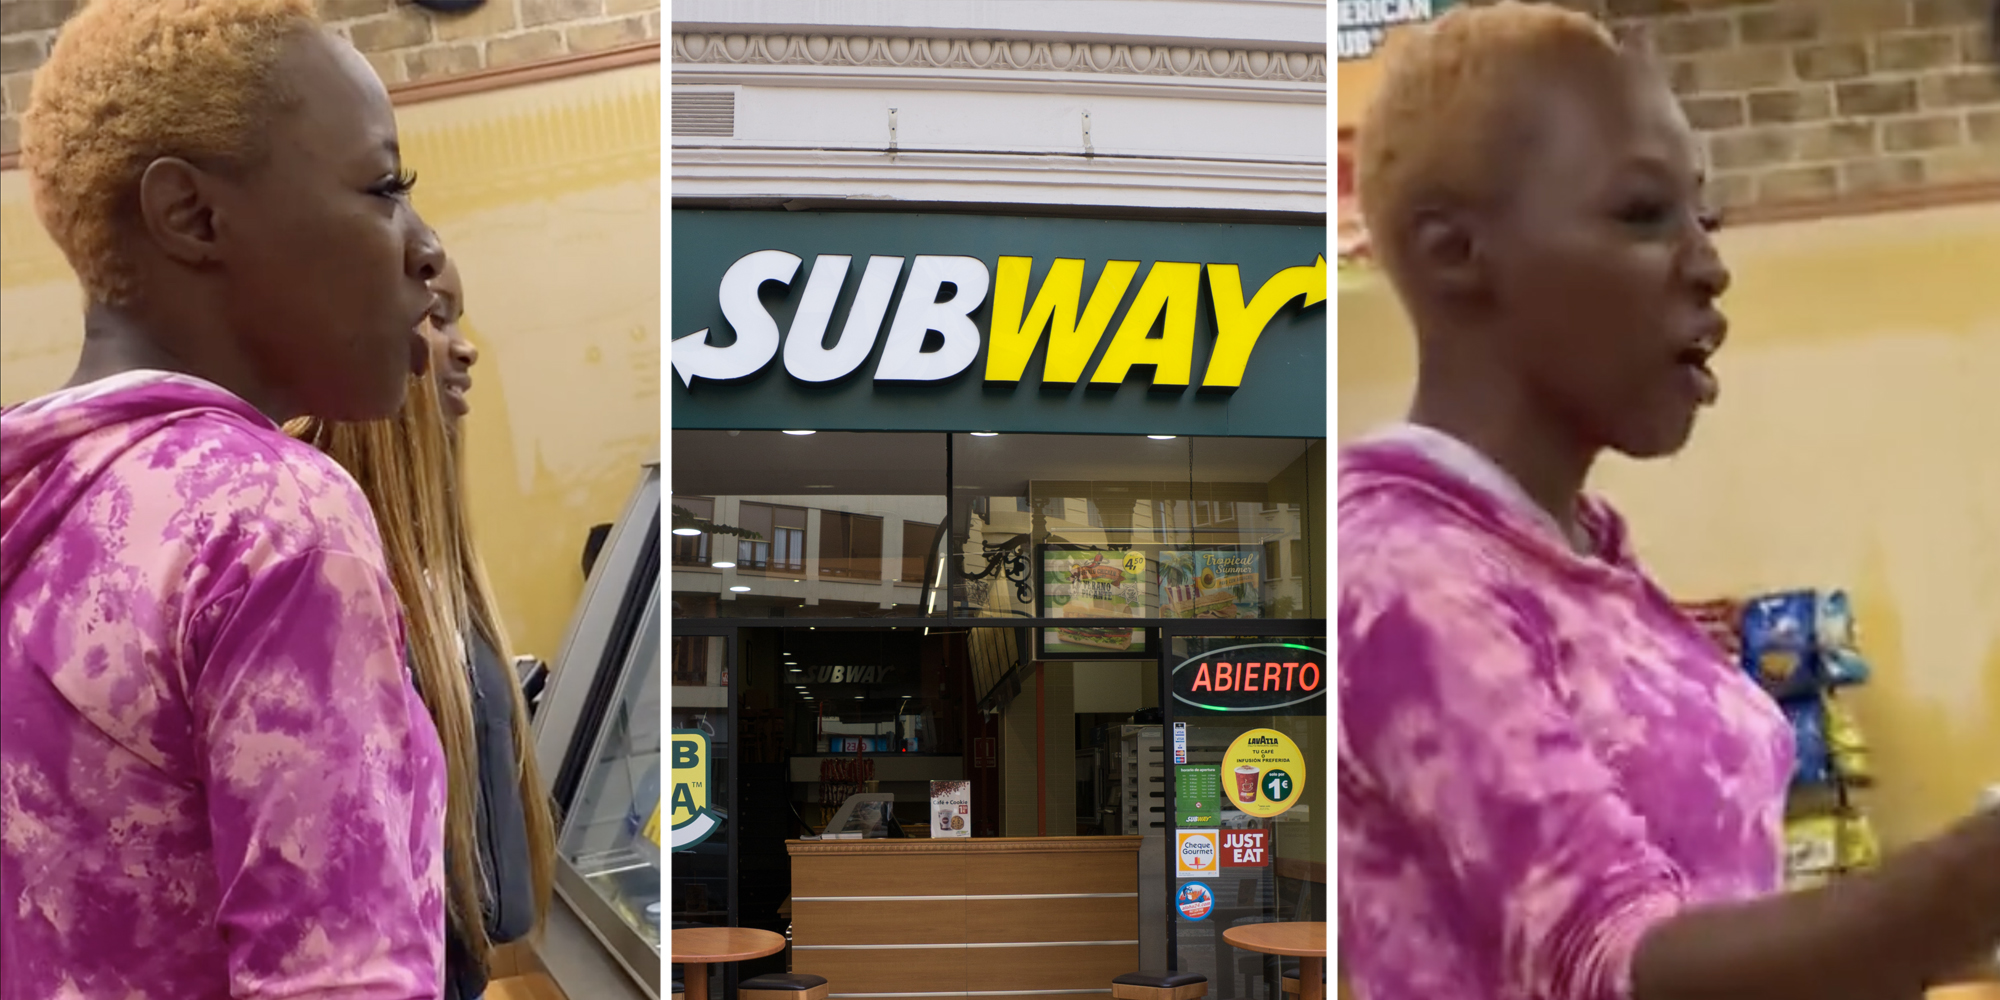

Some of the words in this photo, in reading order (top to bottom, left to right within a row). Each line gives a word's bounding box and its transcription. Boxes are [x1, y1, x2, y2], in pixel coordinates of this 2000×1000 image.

[672, 248, 1326, 394] SUBWAY
[1203, 553, 1254, 566] Tropical
[1215, 565, 1252, 574] Summer
[1083, 580, 1112, 592] VERANO
[1081, 588, 1113, 601] PICANTE
[801, 664, 896, 684] SUBWAY
[1191, 661, 1321, 693] ABIERTO
[1247, 735, 1279, 745] LAVAZZA
[1185, 815, 1212, 823] SUBWAY
[1184, 841, 1211, 849] Cheque
[1223, 833, 1264, 848] JUST
[1233, 848, 1264, 863] EAT
